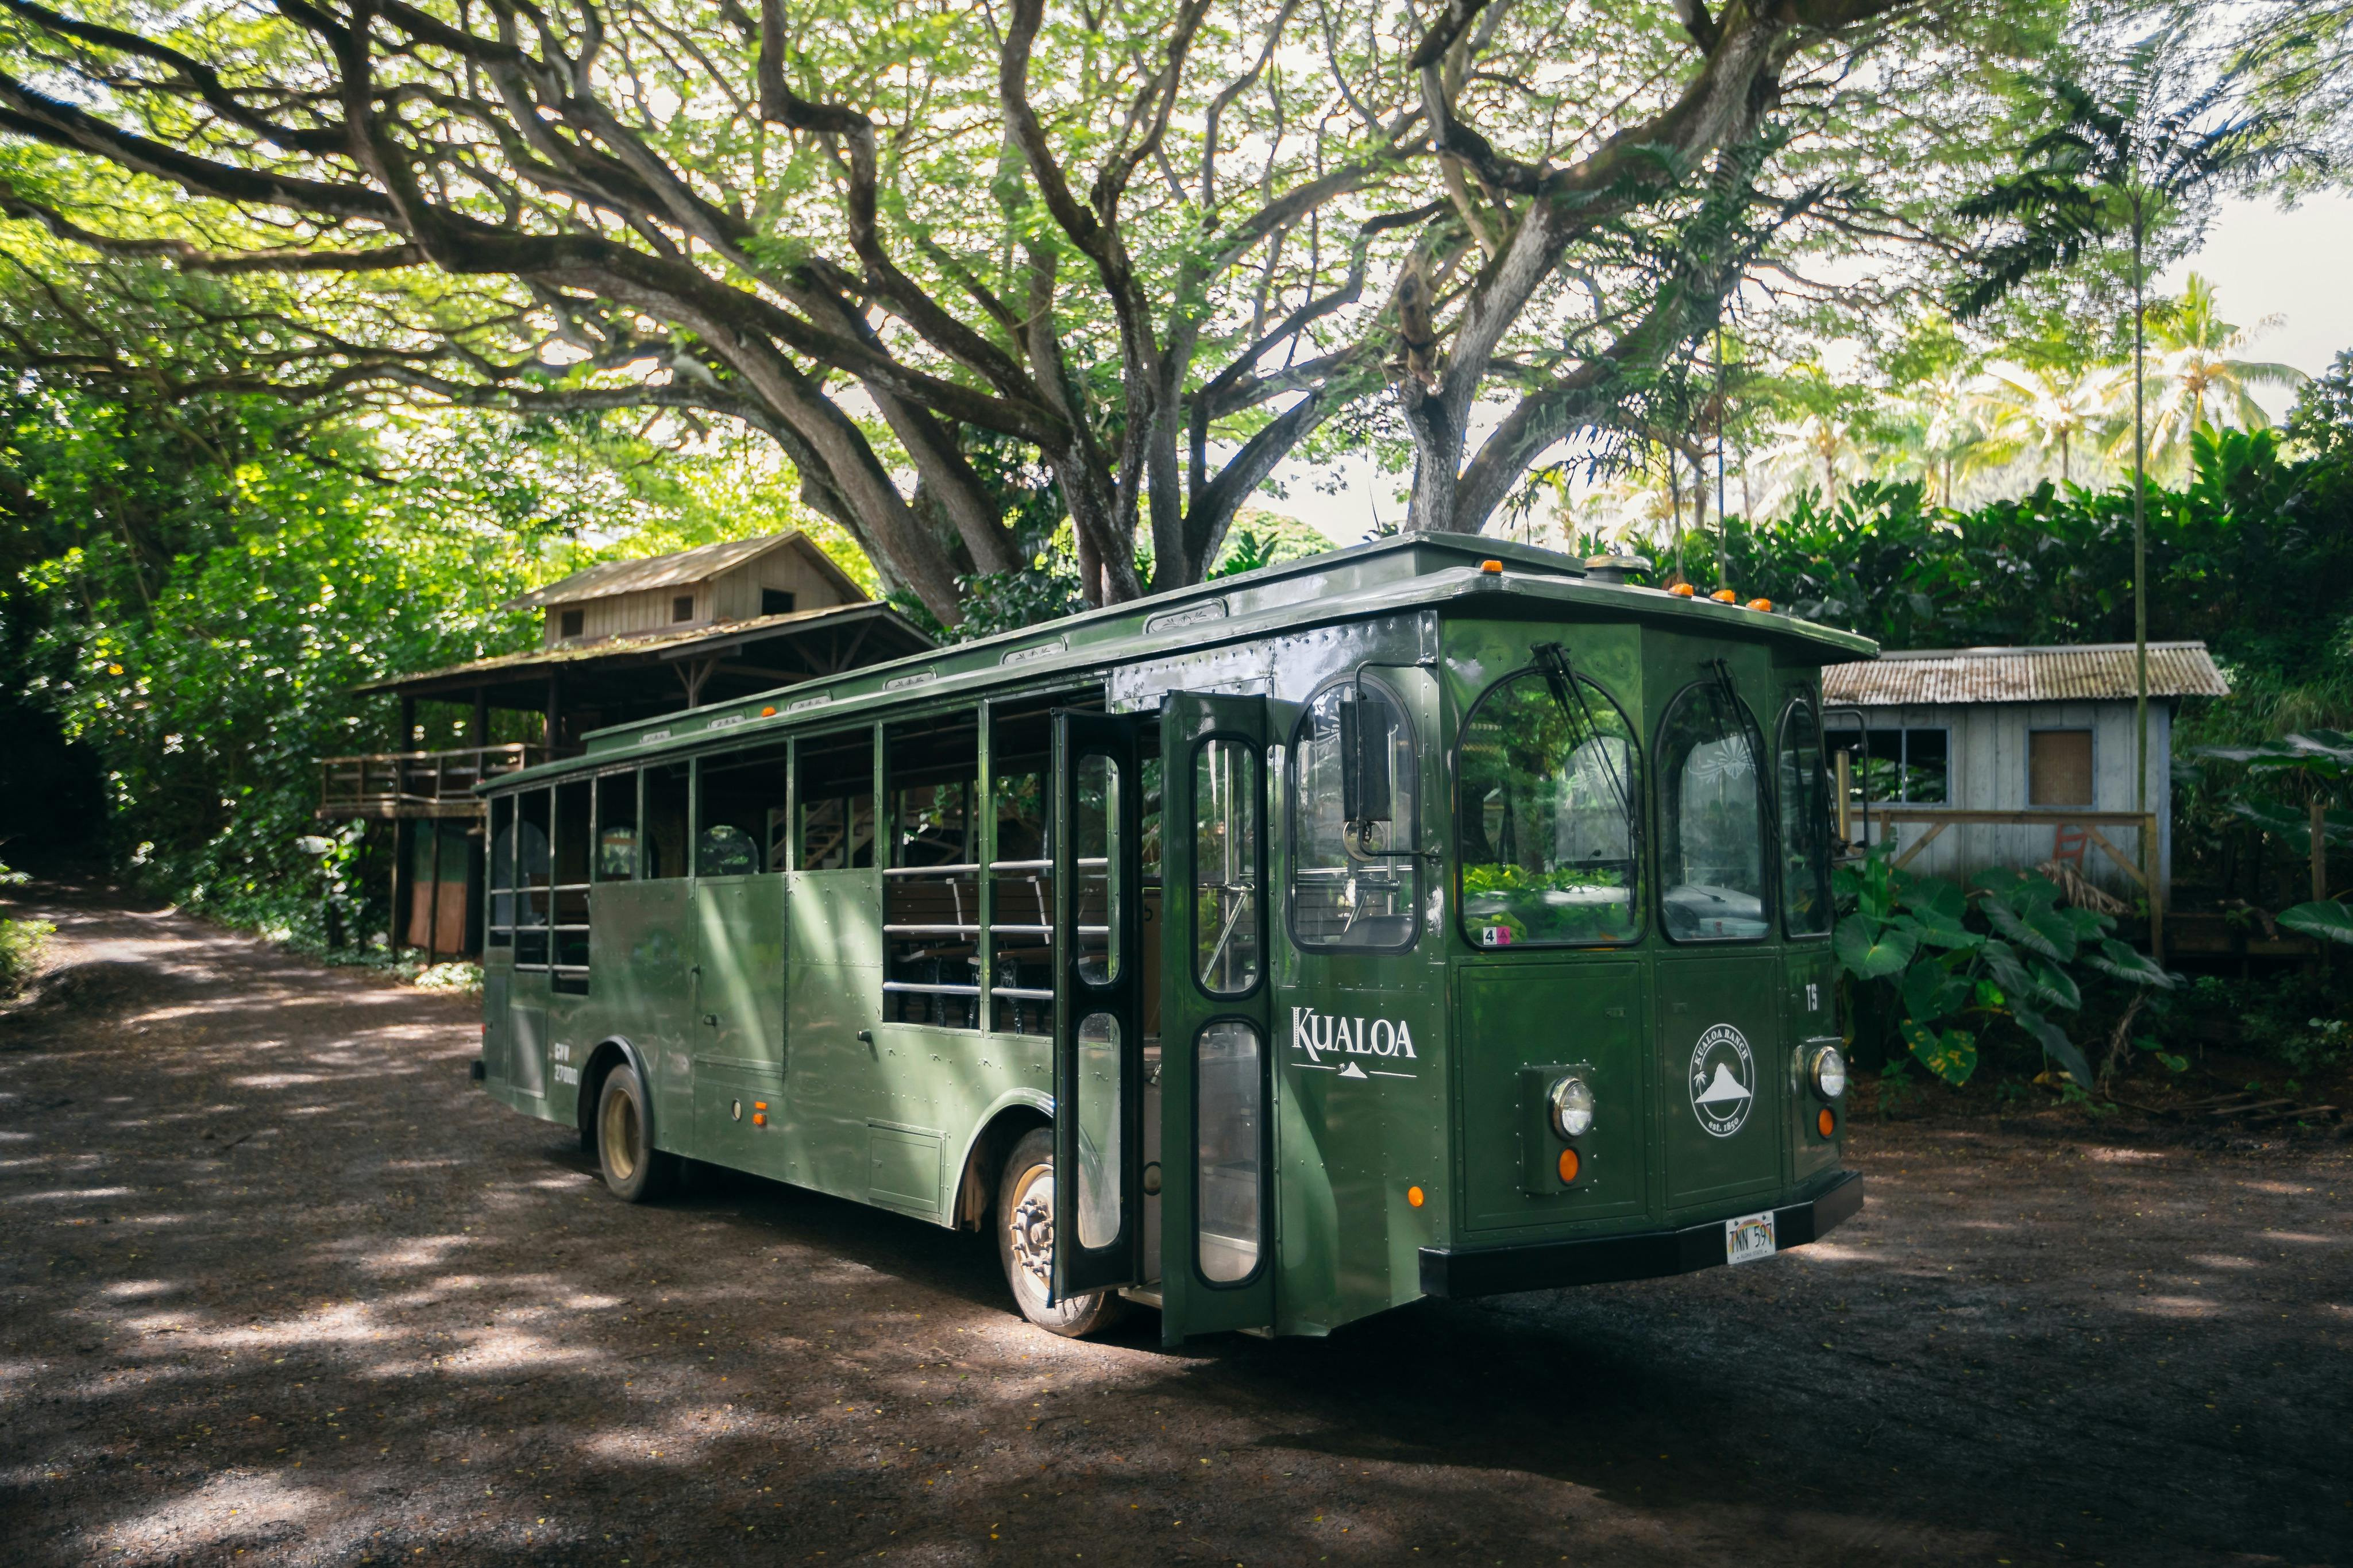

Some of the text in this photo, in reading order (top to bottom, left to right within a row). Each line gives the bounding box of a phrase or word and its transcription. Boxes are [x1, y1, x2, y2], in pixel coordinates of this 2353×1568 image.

[1485, 930, 1494, 942] 4
[1291, 1007, 1417, 1061] KUALOA
[1695, 1029, 1748, 1065] KUALOA RANCH
[1708, 1117, 1739, 1131] est. 1850
[1729, 1223, 1772, 1253] TNN 597
